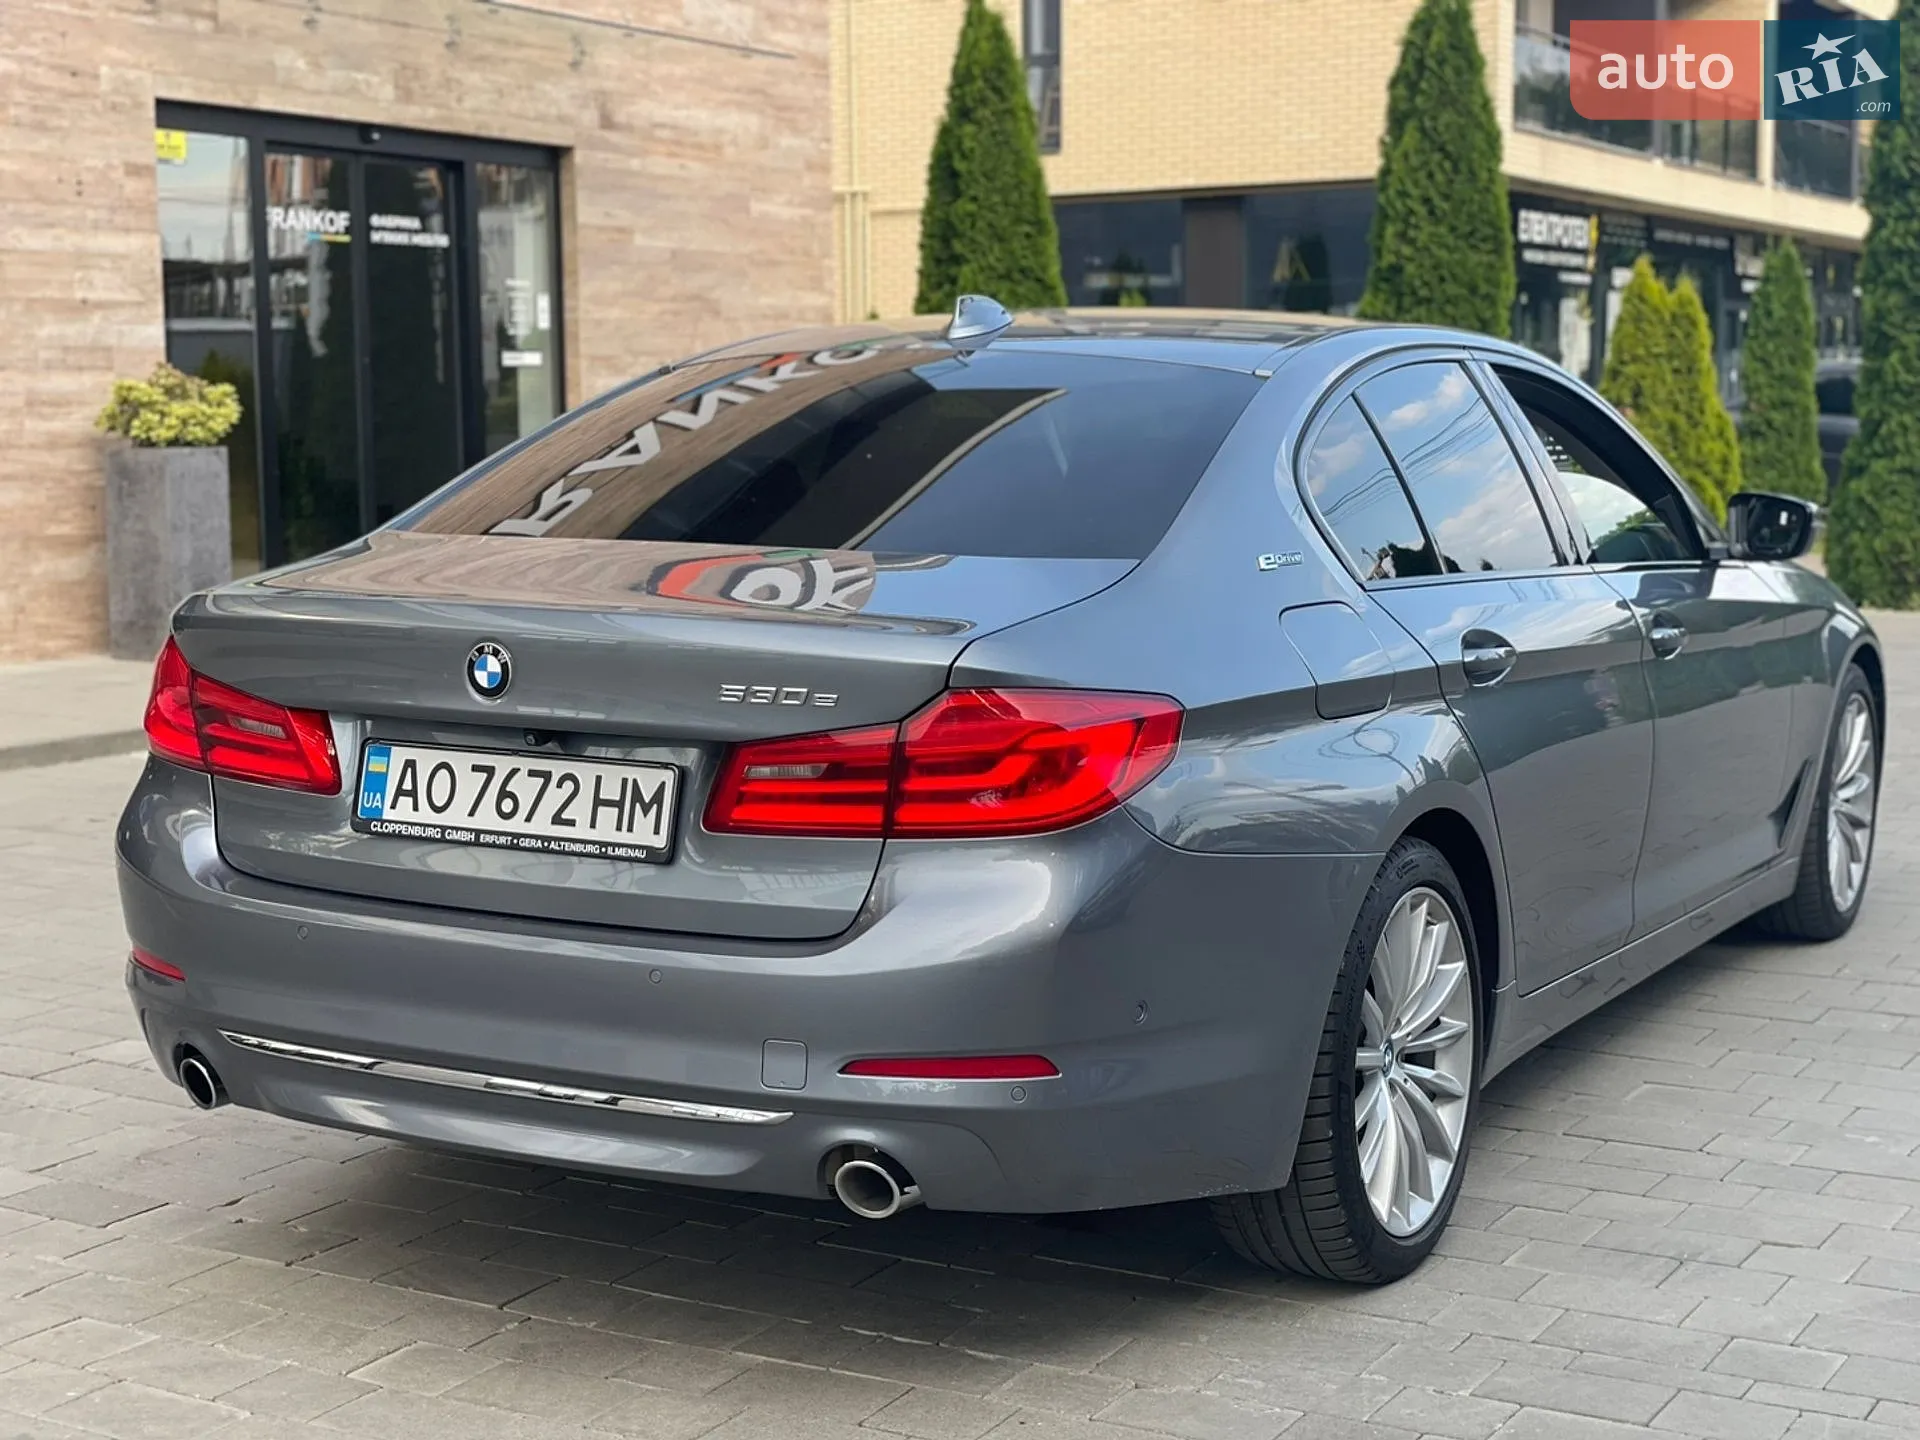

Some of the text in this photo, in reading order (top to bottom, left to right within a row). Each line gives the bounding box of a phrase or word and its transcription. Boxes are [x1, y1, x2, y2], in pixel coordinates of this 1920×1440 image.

[720, 684, 838, 707] 530e
[363, 791, 382, 809] UA
[389, 758, 666, 835] AO 7672 HM
[370, 820, 442, 839] CLOPPENBURG
[479, 833, 512, 845] ERFURT
[519, 838, 542, 848] GERA
[549, 840, 600, 853] ALTENBURG
[607, 846, 647, 858] ILMENAU
